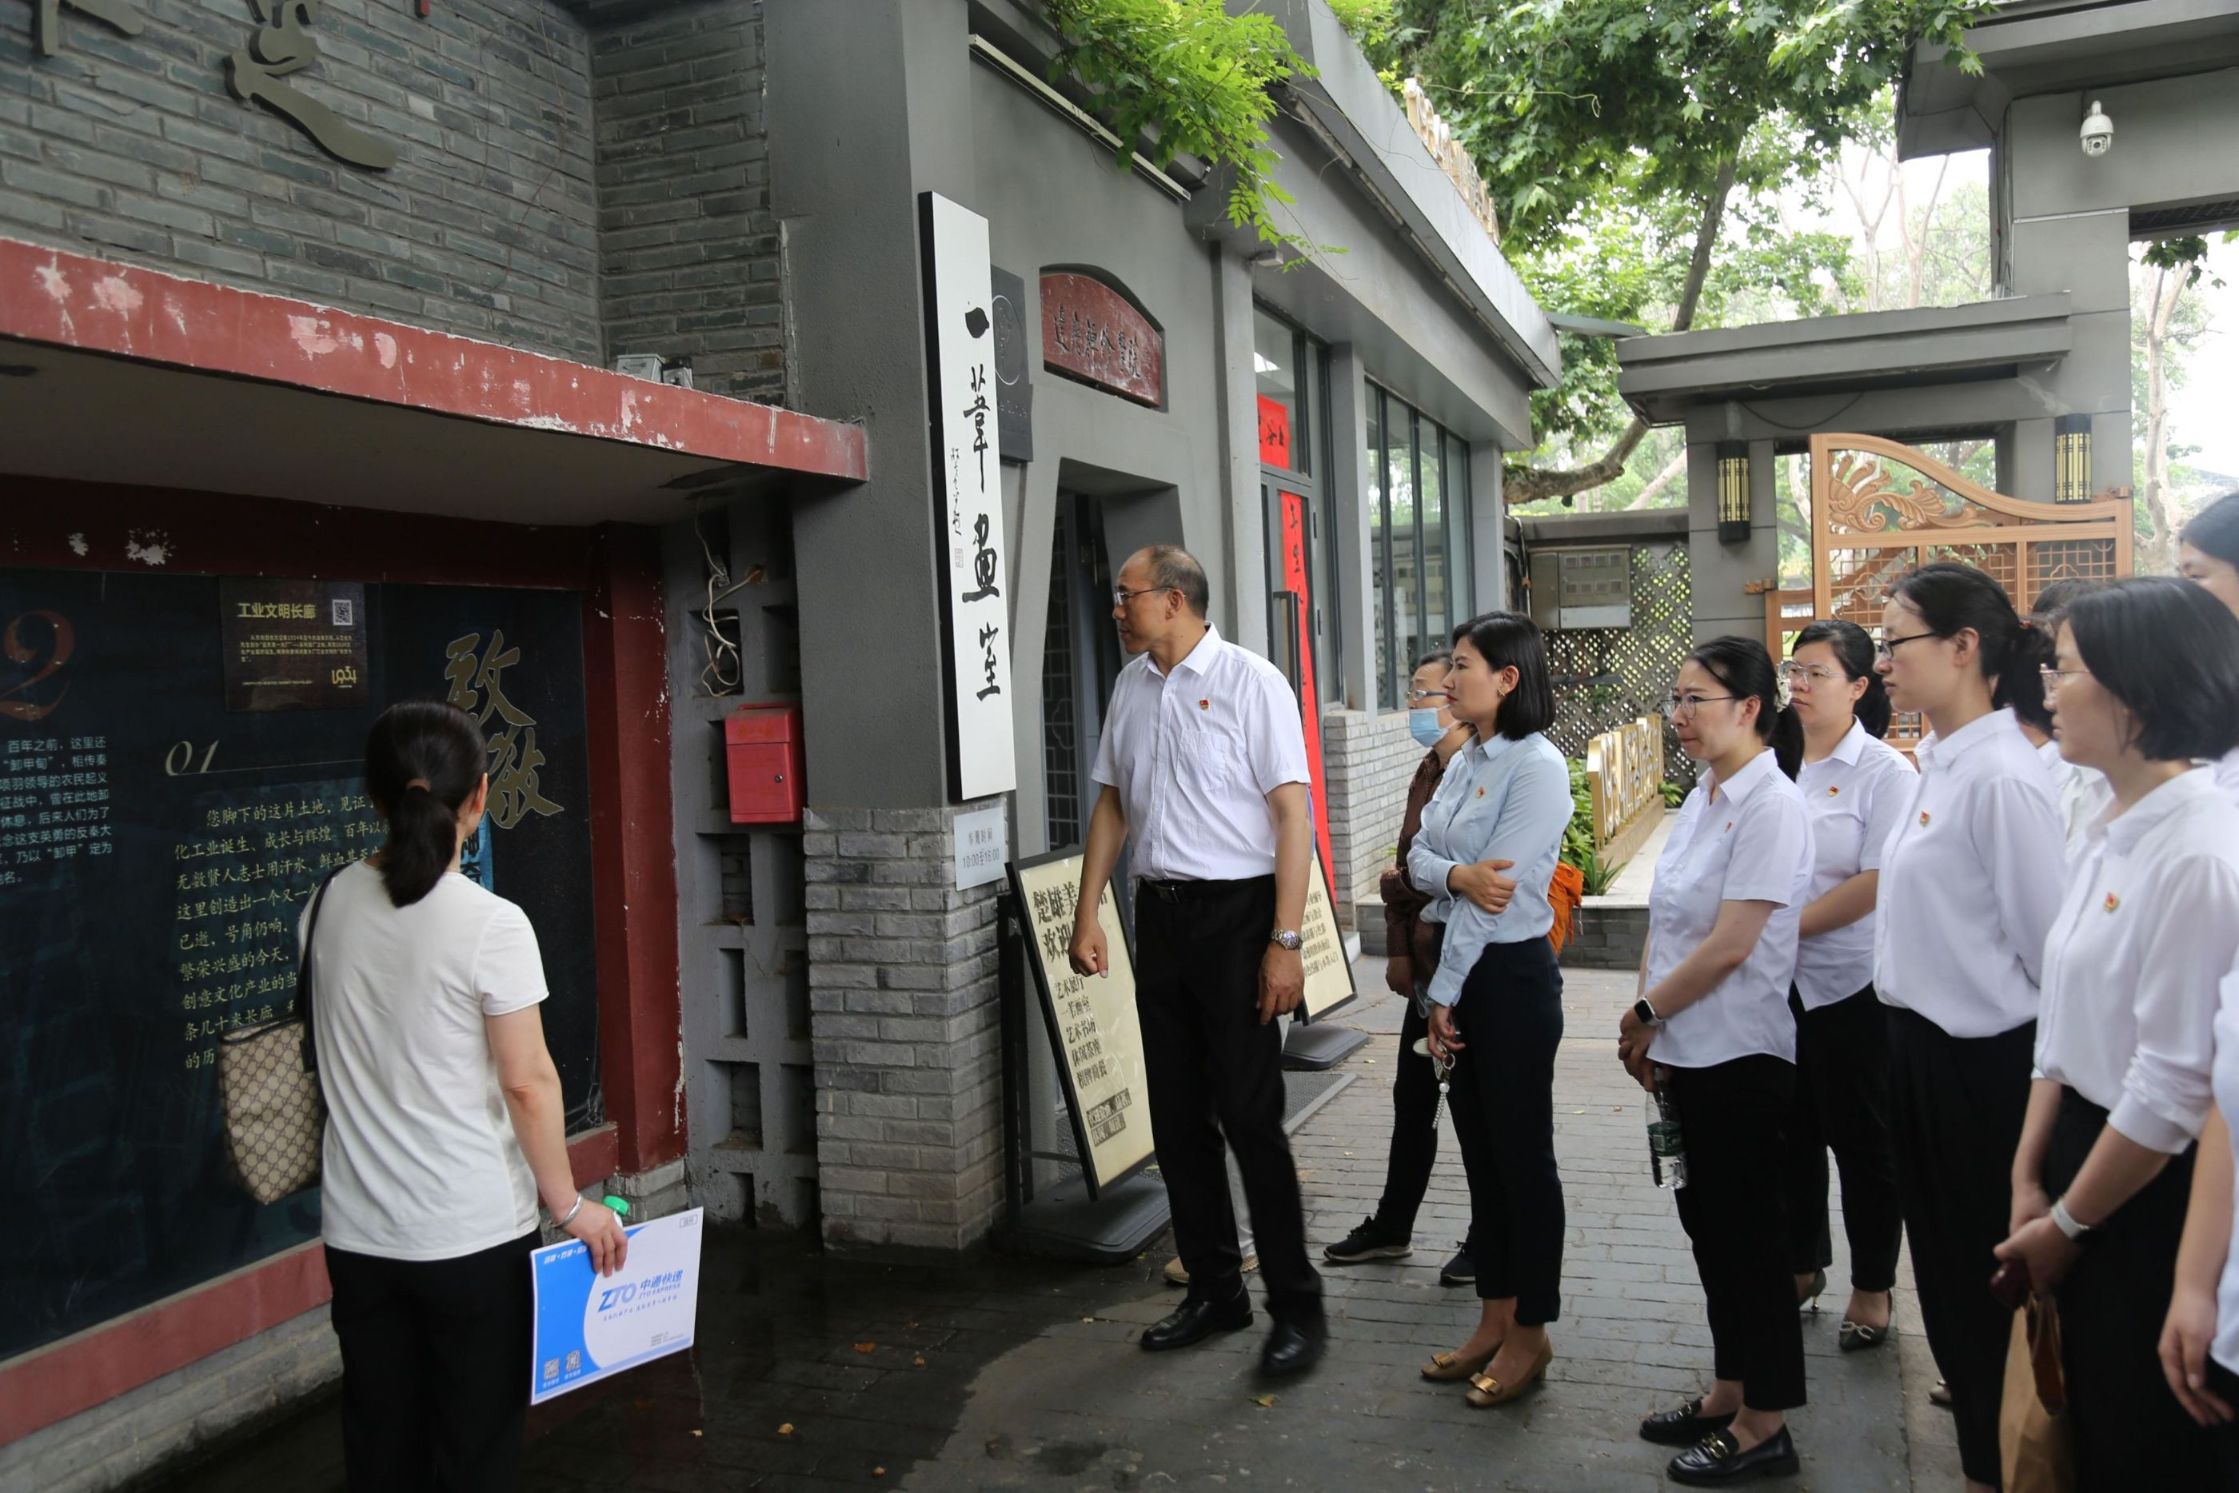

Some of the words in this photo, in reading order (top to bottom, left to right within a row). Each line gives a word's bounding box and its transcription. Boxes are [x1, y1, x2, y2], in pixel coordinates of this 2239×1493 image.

[237, 602, 317, 619] 工业文明长廊
[444, 629, 565, 829] 致敬
[165, 739, 220, 776] 01
[640, 1270, 684, 1291] 中通快递
[598, 1282, 638, 1314] ZTO
